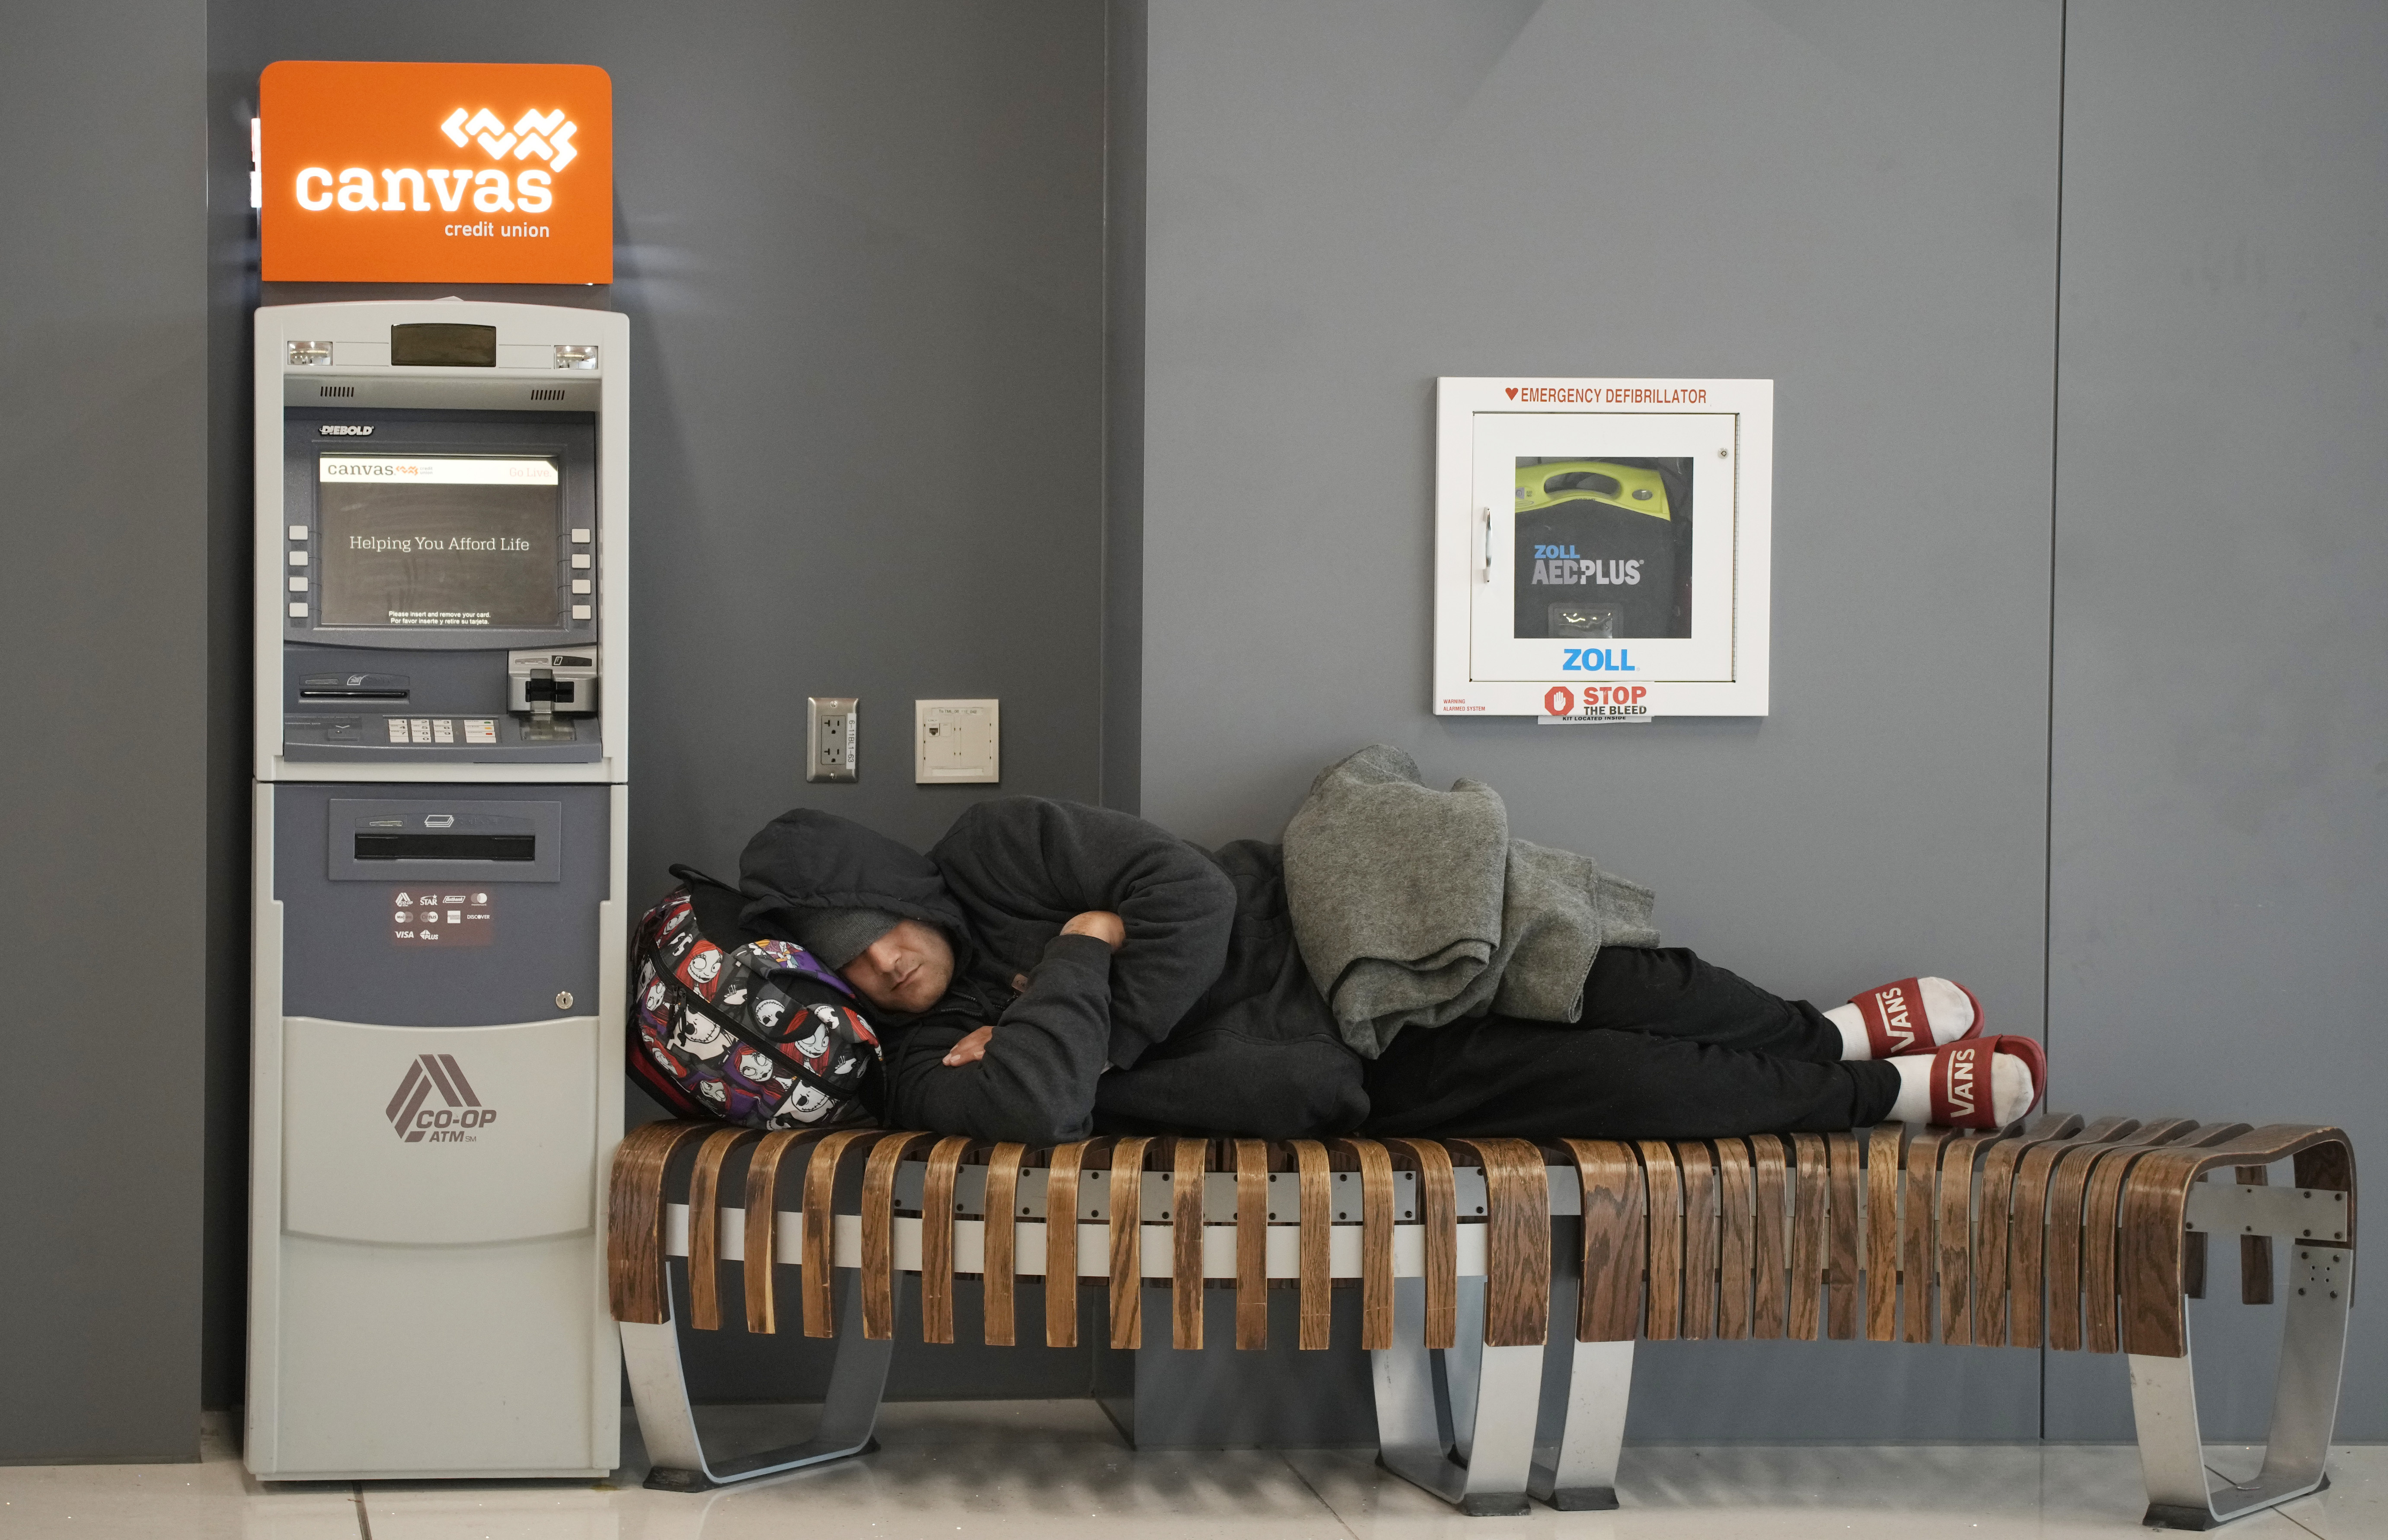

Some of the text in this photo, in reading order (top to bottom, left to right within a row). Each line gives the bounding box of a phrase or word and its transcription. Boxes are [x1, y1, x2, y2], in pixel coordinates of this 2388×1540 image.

[296, 167, 552, 213] canvas
[445, 222, 550, 238] credit union
[1521, 388, 1706, 403] EMERGENCY DEFIBRILLATOR
[328, 465, 394, 476] canvas
[509, 468, 552, 478] Go Live.
[349, 536, 530, 553] Helping You Afford Life
[1534, 545, 1580, 559] ZOLL
[1562, 648, 1635, 672] ZOLL
[1583, 686, 1647, 705] STOP
[1584, 705, 1647, 715] THE BLEED
[1875, 987, 1915, 1053] VANS
[1947, 1049, 1975, 1118] VANS
[416, 1110, 497, 1129] CO-OP
[429, 1131, 465, 1142] ATM
